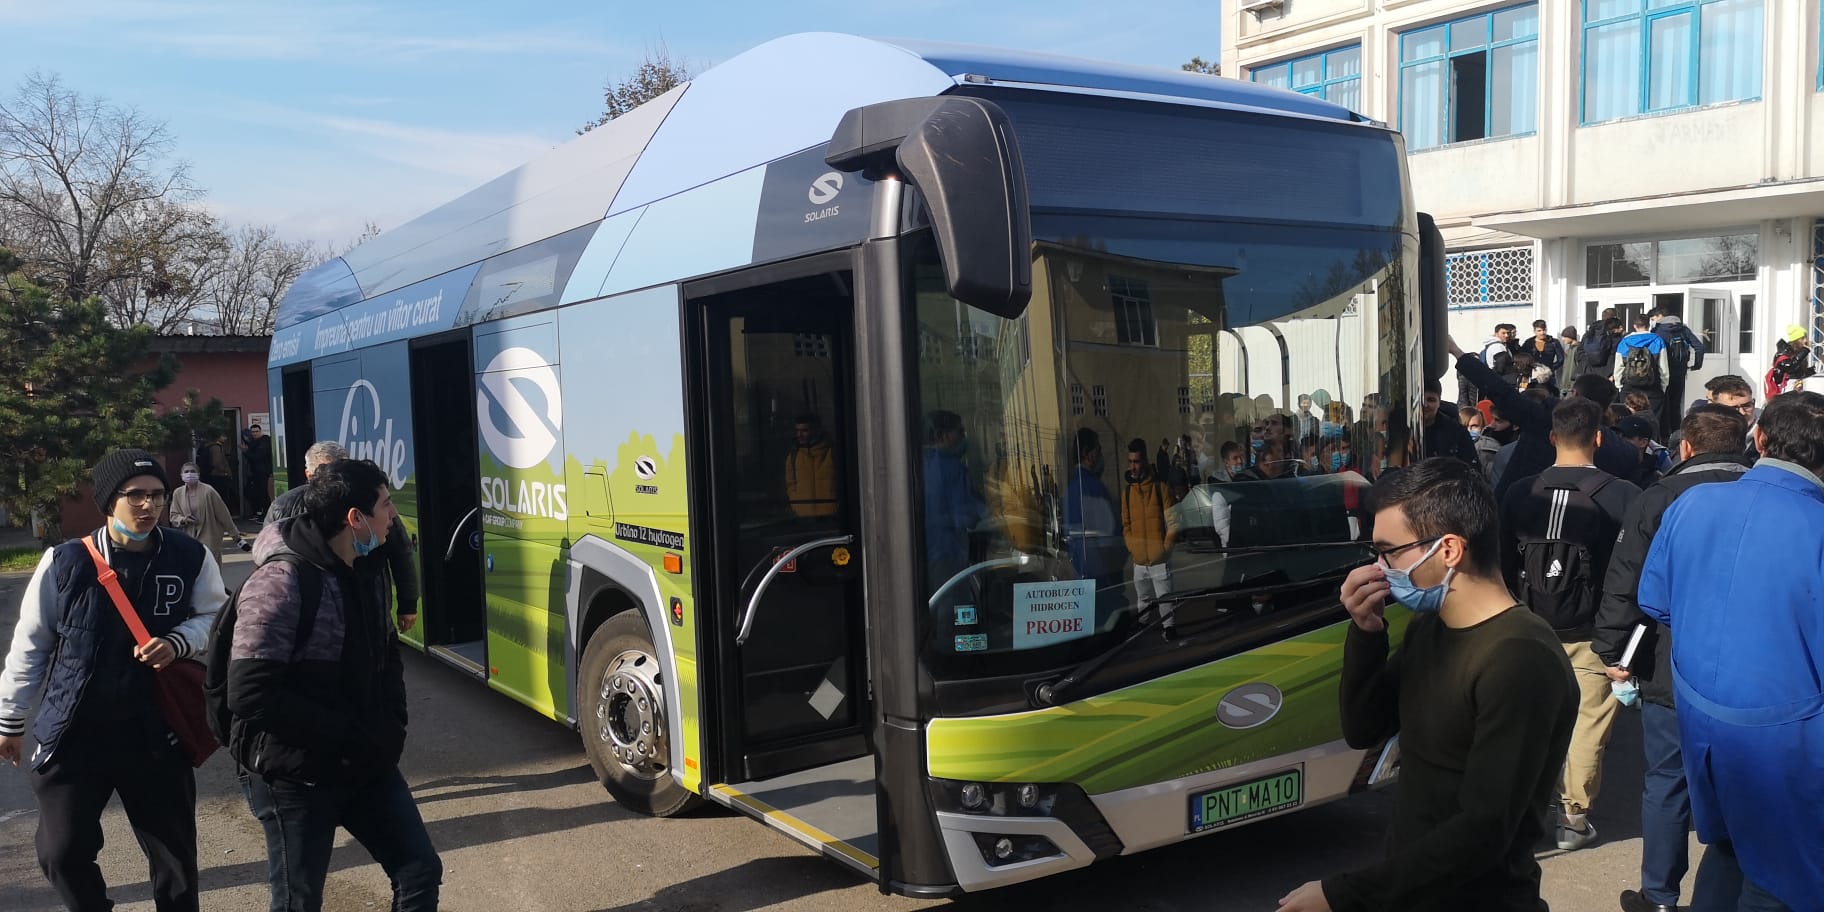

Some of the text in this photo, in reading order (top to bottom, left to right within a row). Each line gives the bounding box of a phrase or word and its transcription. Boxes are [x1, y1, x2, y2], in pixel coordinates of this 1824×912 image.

[804, 205, 840, 223] SOLARIS
[373, 310, 387, 336] un
[412, 288, 443, 326] curat
[480, 476, 567, 521] SOLARIS
[615, 522, 684, 549] Urbino 12 hydrogen
[154, 575, 185, 616] P
[1025, 587, 1085, 600] AUTOBUZ CU
[1030, 601, 1080, 613] HIDROGEN
[1026, 617, 1083, 635] PROBE
[1206, 789, 1242, 821] PNT
[1249, 776, 1294, 810] MA10
